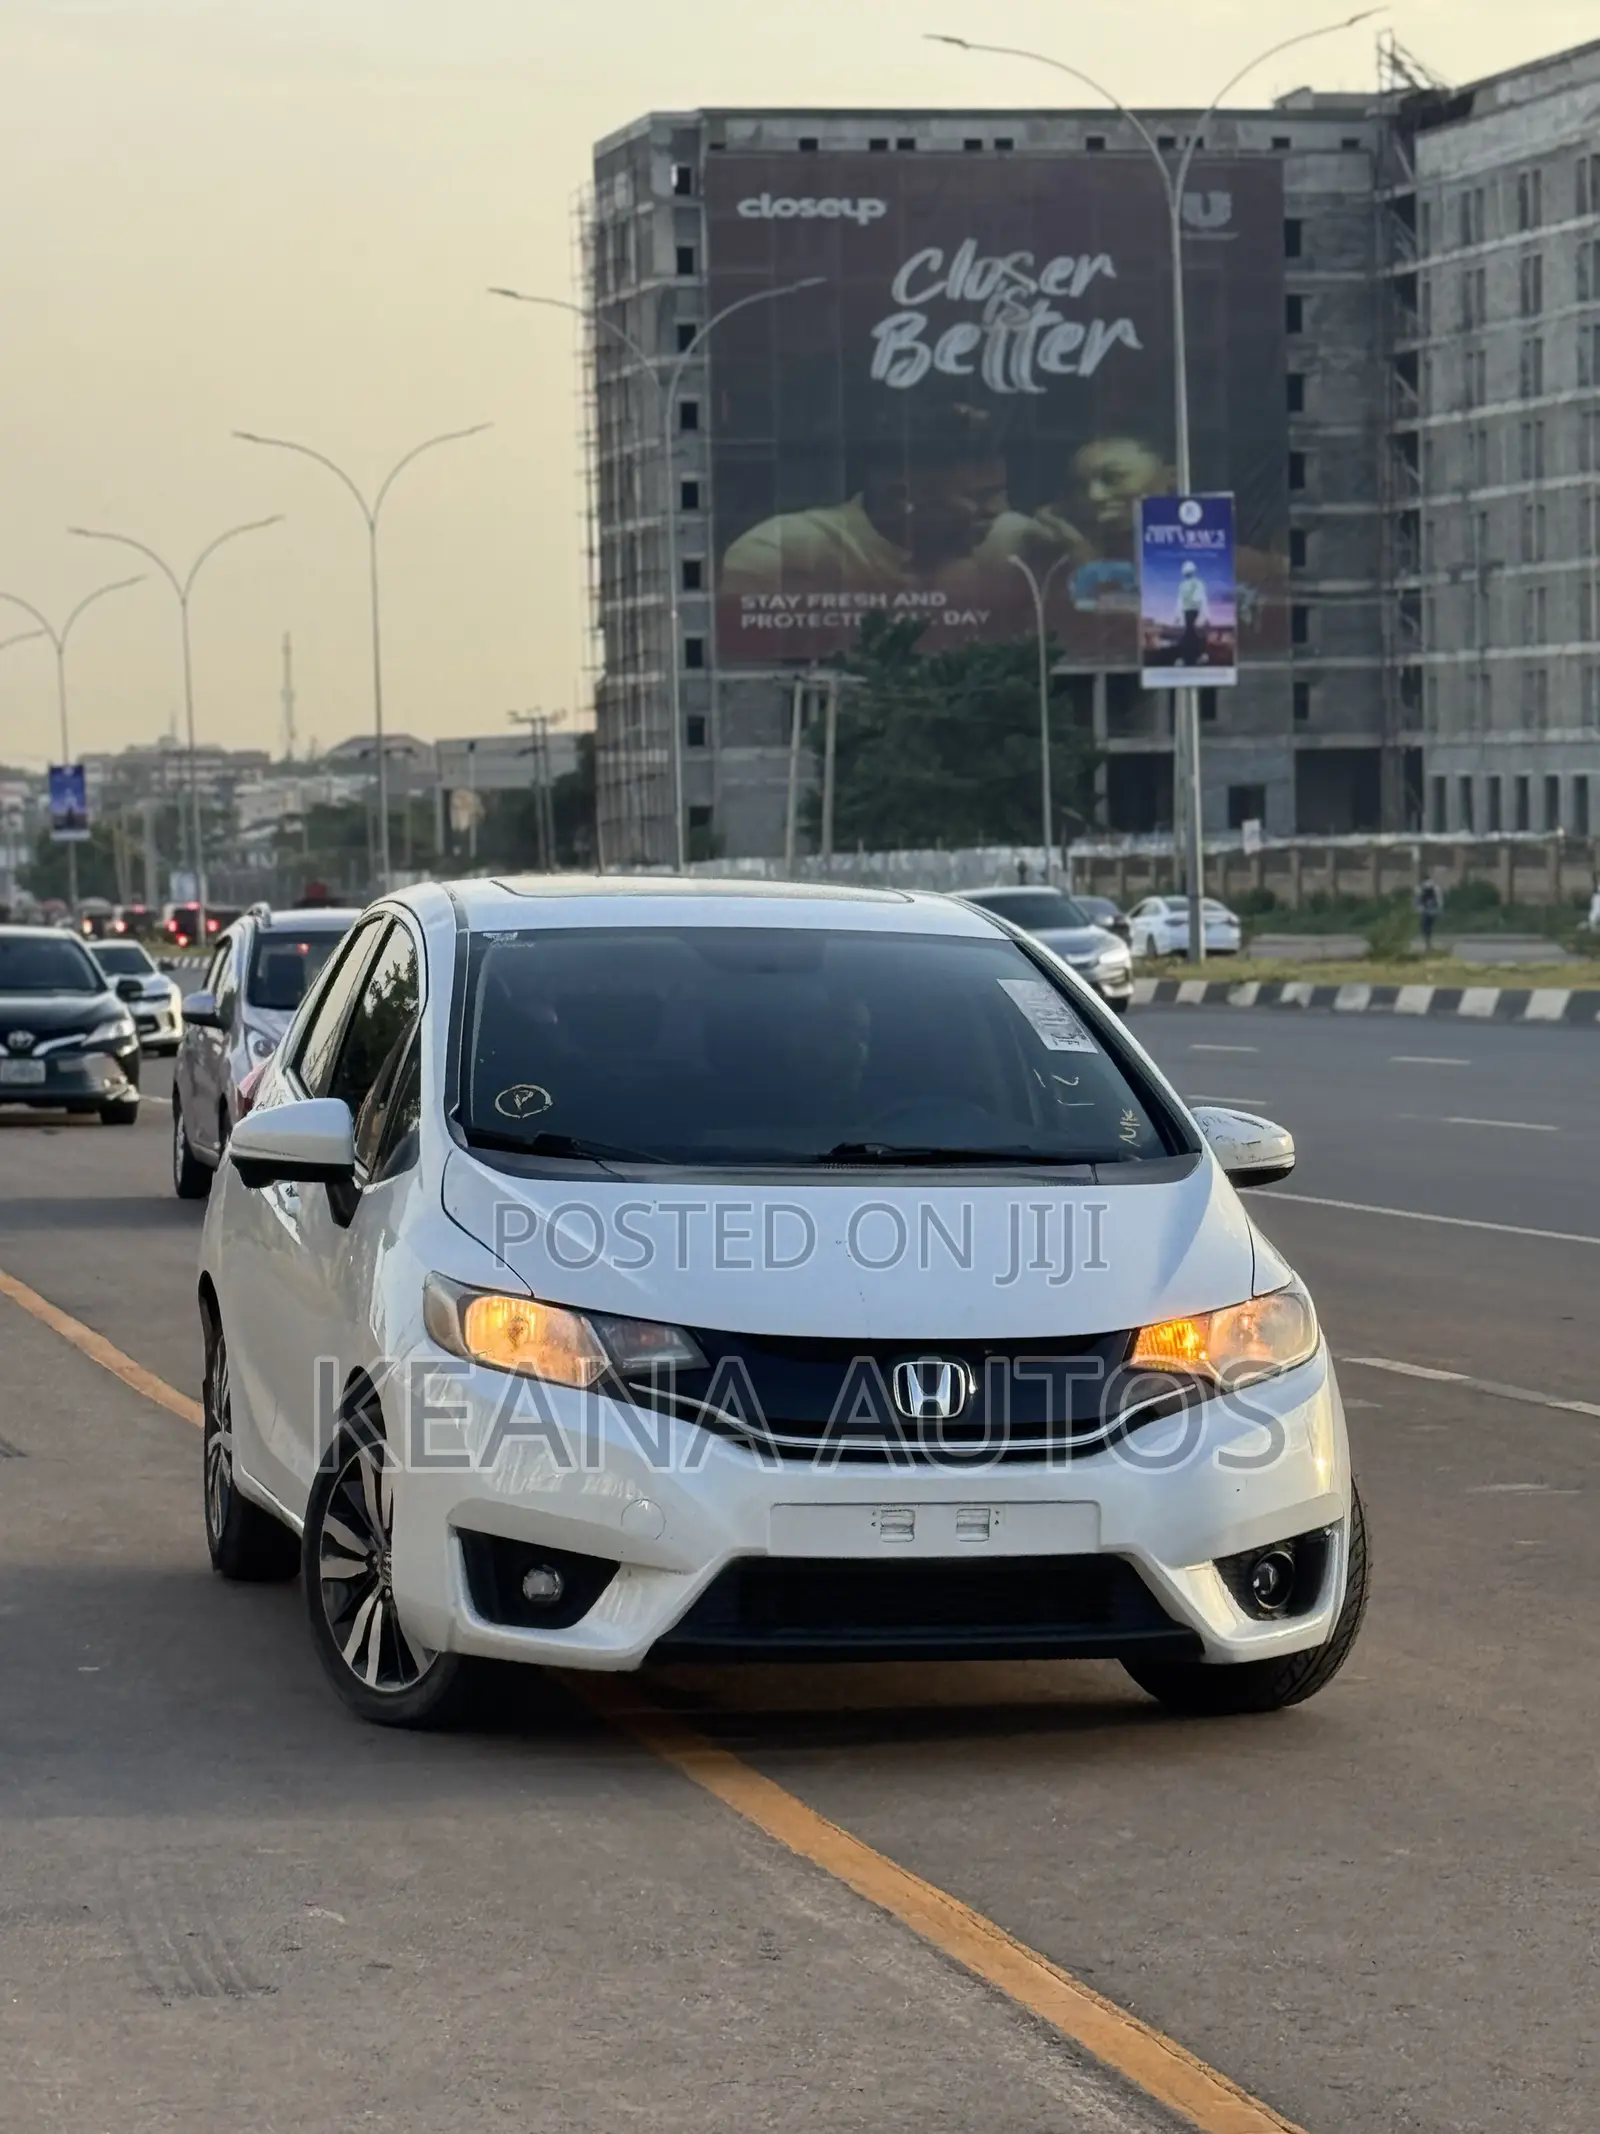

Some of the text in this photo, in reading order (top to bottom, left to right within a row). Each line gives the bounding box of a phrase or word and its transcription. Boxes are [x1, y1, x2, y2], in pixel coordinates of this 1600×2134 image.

[736, 191, 888, 226] closeup
[891, 238, 1117, 306] Closer
[870, 299, 1144, 394] Better
[741, 591, 948, 610] STAY FRESH AND
[942, 608, 991, 626] DAY
